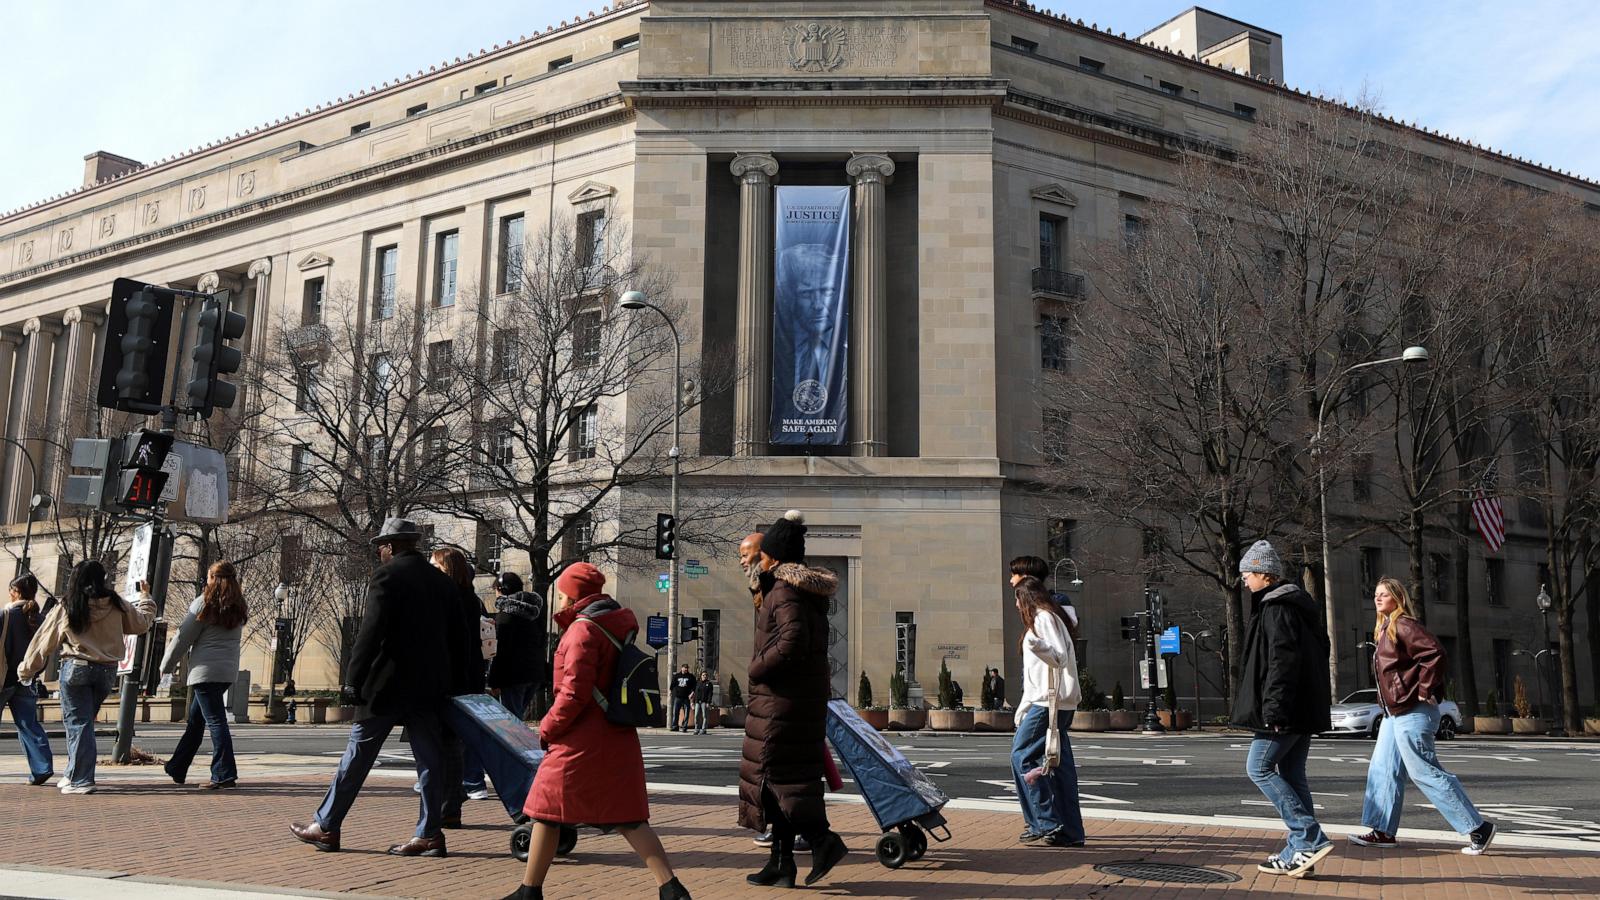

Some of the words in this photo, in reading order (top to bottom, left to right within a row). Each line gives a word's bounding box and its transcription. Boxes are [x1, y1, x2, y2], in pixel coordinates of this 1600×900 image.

[786, 211, 840, 219] JUSTICE
[782, 425, 806, 433] SAFE
[807, 425, 837, 433] AGAIN
[129, 474, 153, 501] 31
